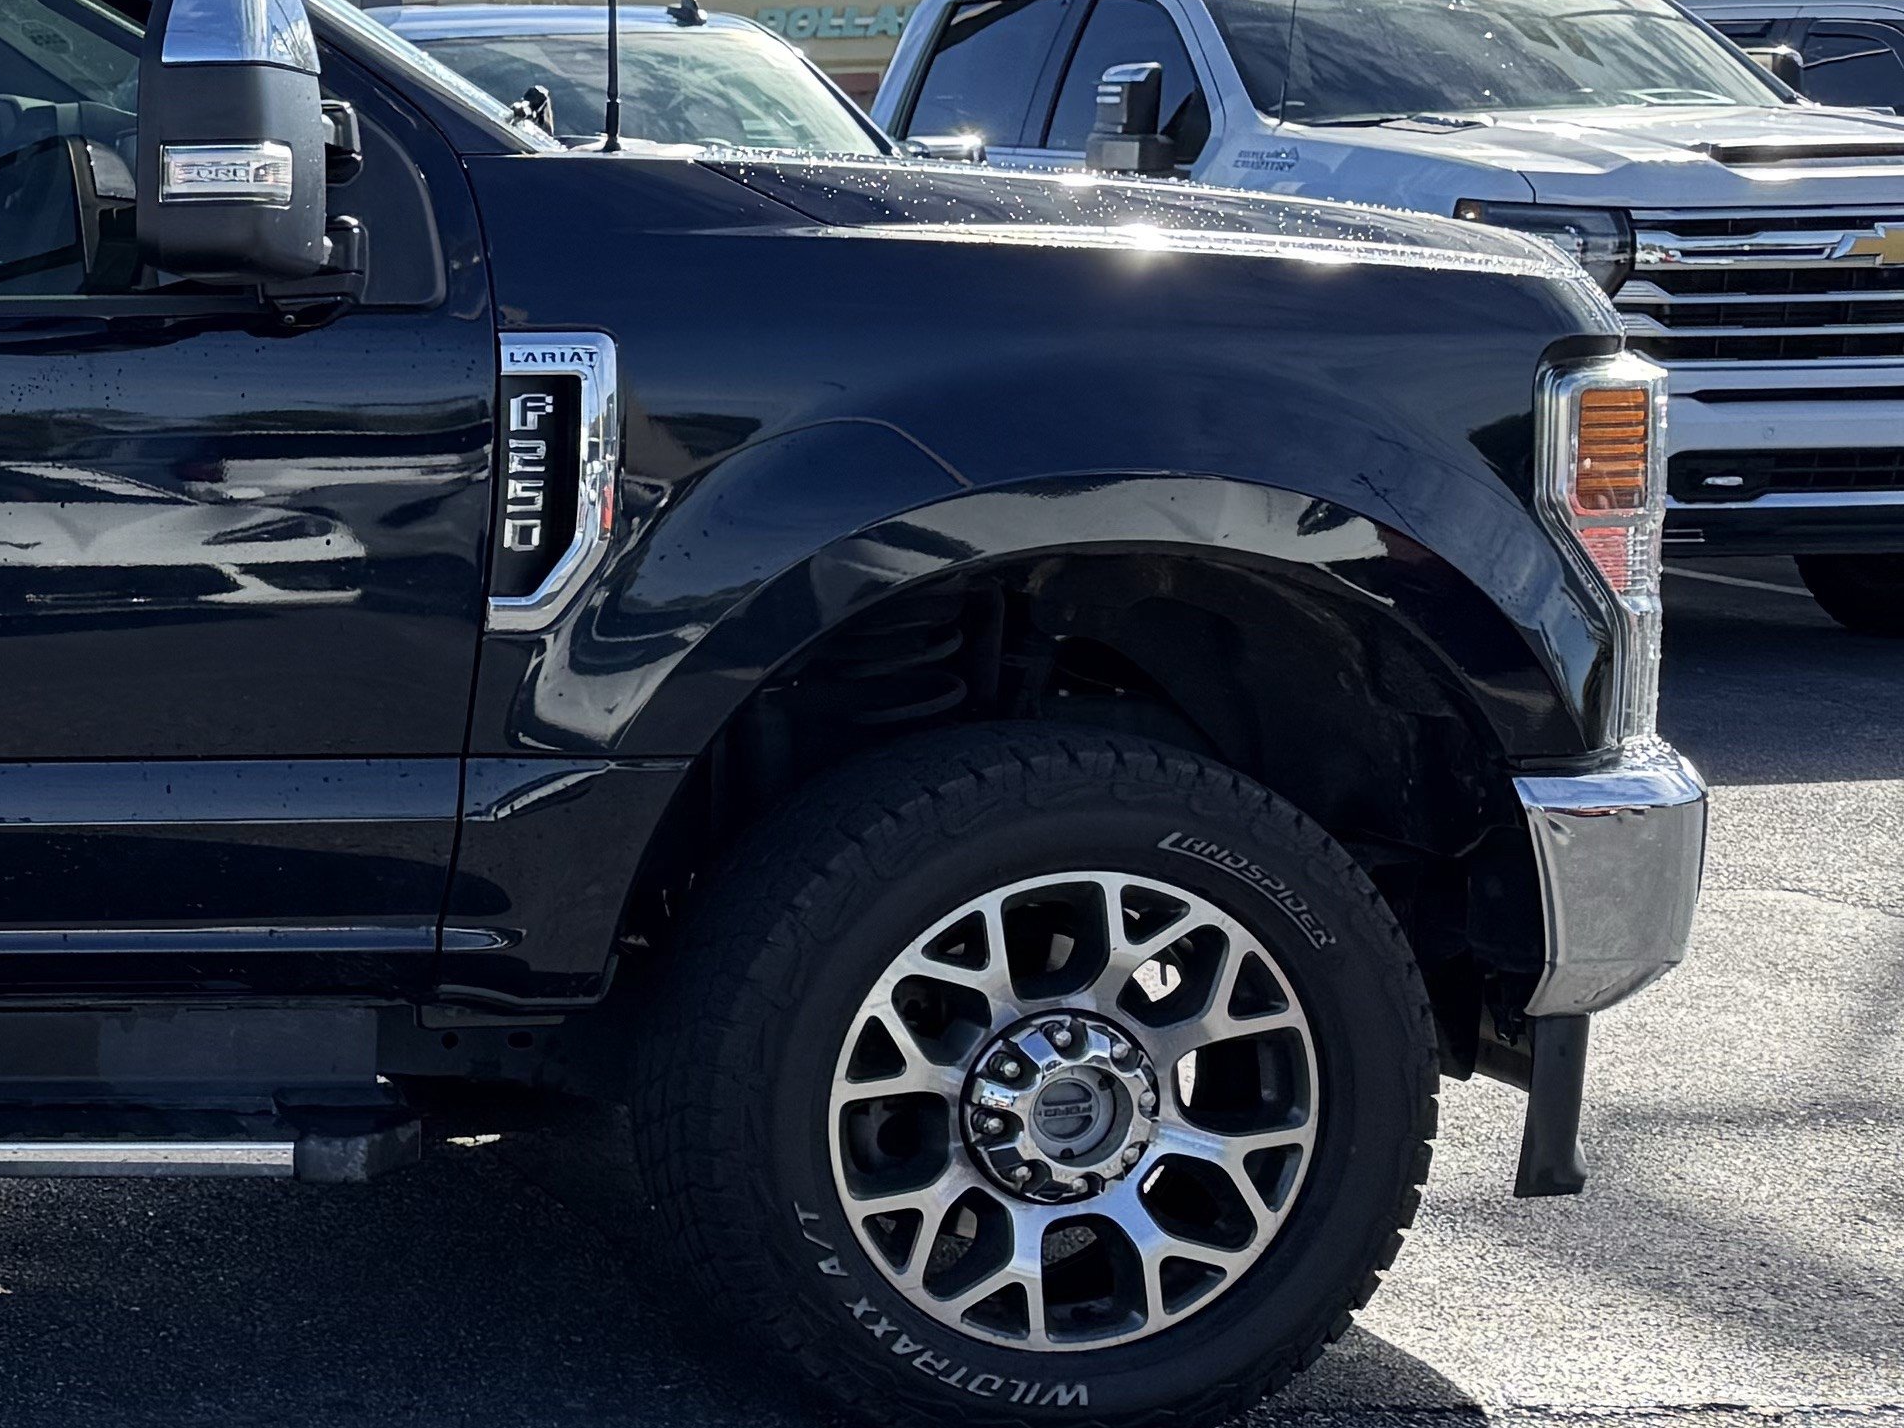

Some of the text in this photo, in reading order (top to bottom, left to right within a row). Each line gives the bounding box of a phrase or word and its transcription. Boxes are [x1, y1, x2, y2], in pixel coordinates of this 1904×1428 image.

[509, 351, 598, 364] LARIAT
[1157, 832, 1336, 950] LANDSPIDER
[794, 1201, 1090, 1406] WILDTRAXX A/T
